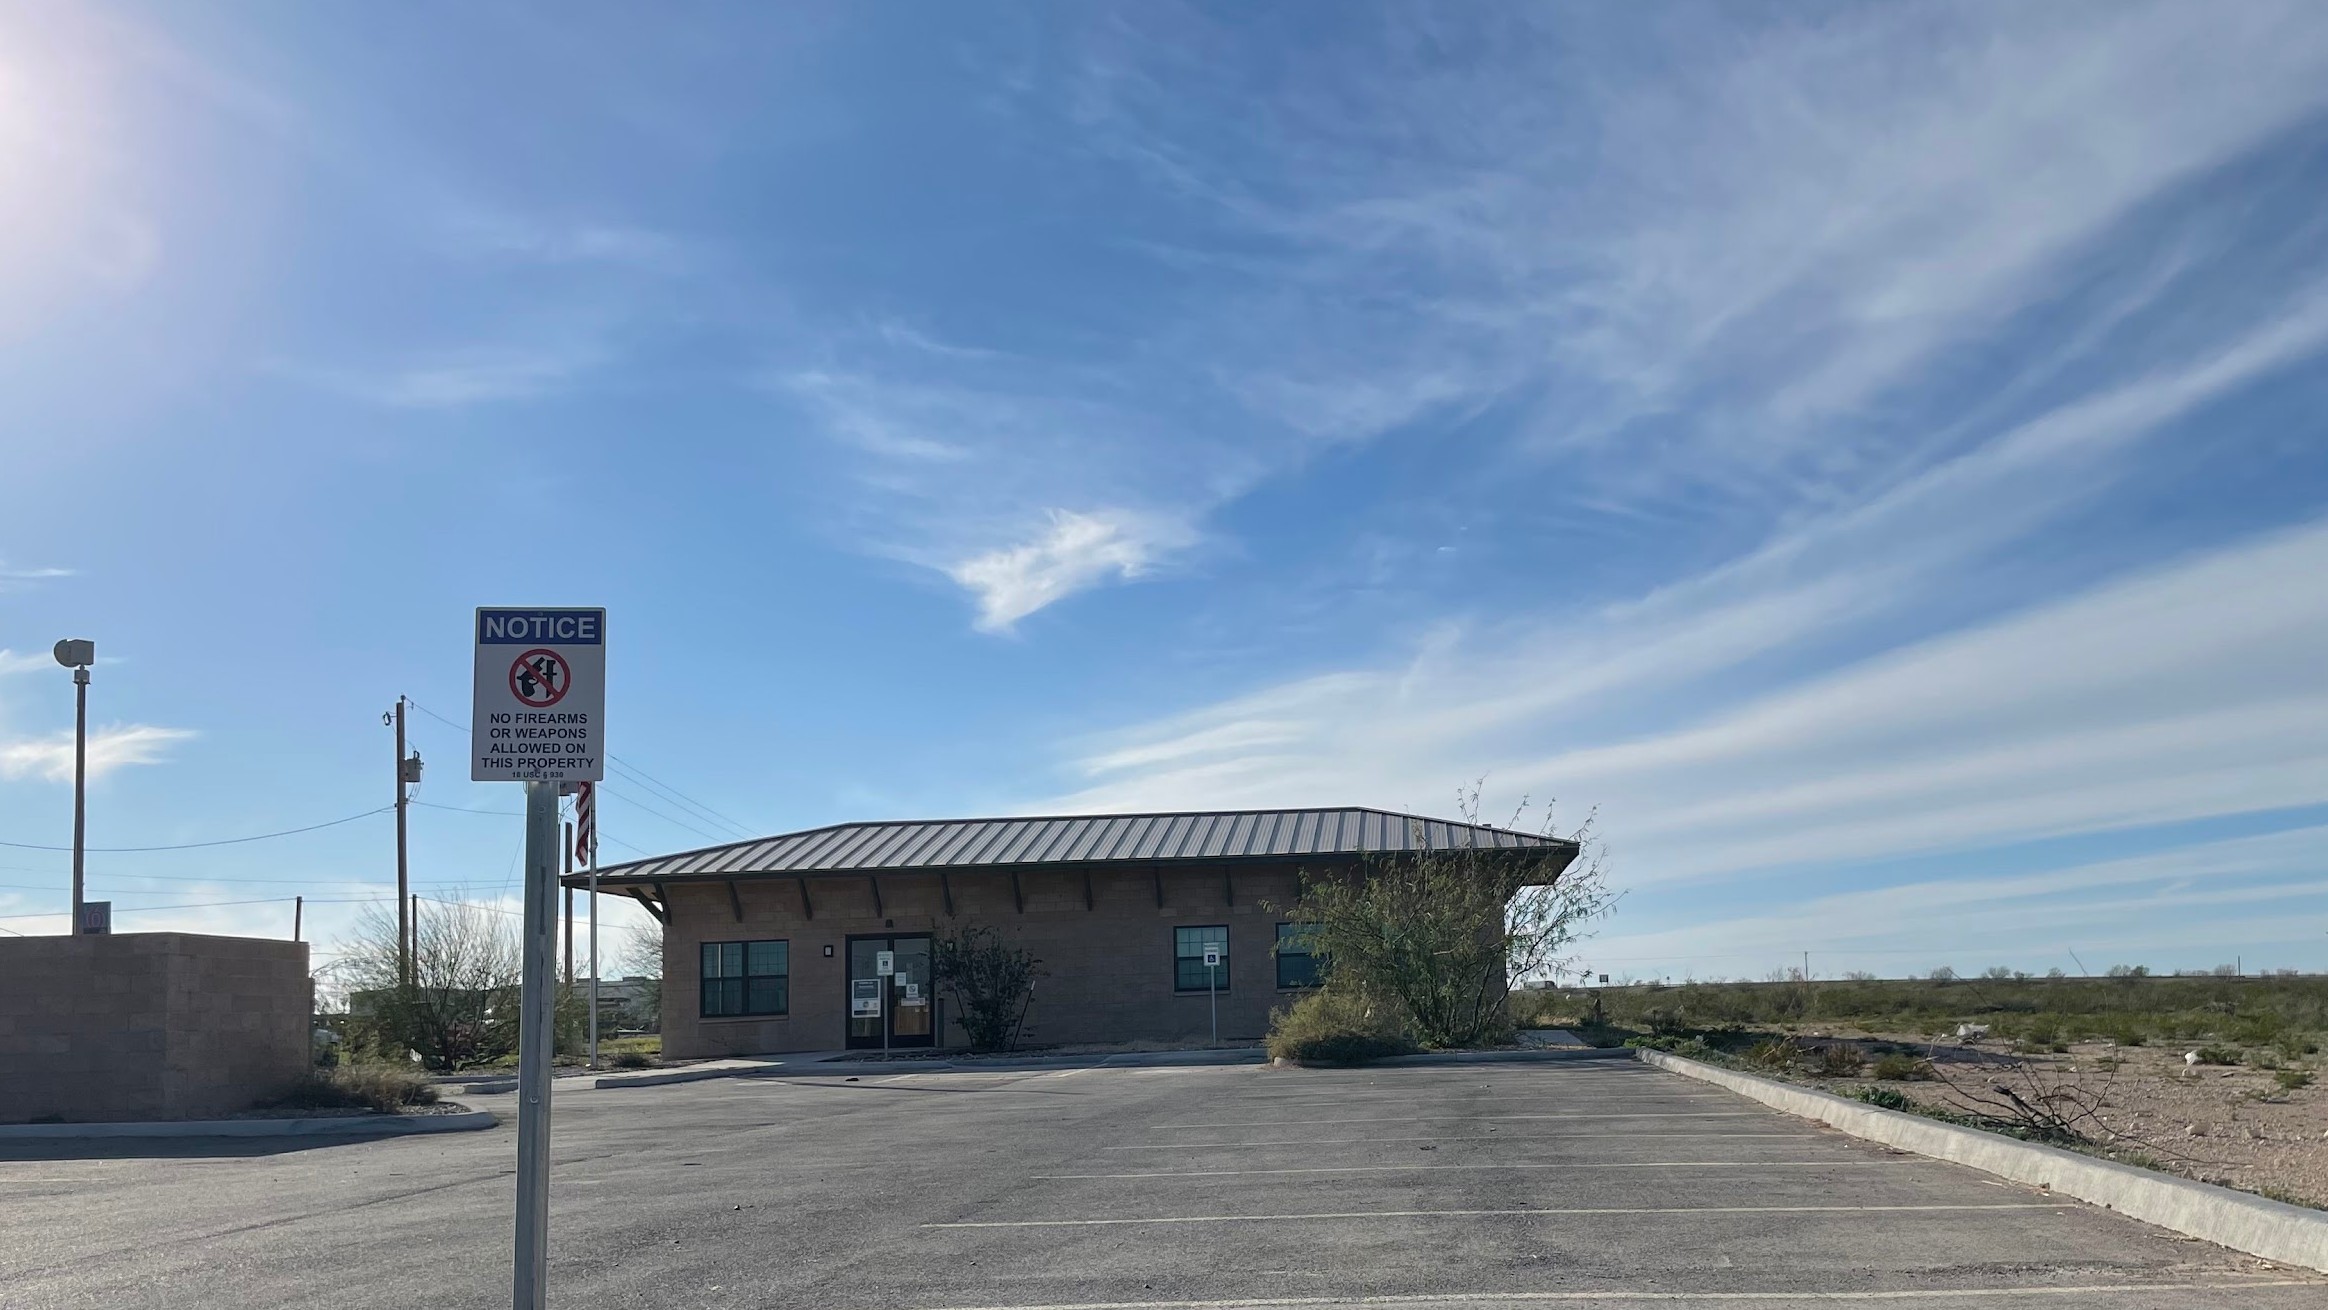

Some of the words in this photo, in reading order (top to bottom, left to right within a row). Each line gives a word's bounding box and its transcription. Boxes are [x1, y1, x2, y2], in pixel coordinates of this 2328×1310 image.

[486, 616, 595, 638] NOTICE
[490, 713, 511, 724] NO
[515, 713, 588, 724] FIREARMS
[490, 728, 511, 739] OR
[515, 728, 587, 739] WEAPONS
[490, 743, 561, 754] ALLOWED
[565, 743, 586, 754] ON
[482, 758, 513, 768] THIS
[517, 758, 594, 768] PROPERTY
